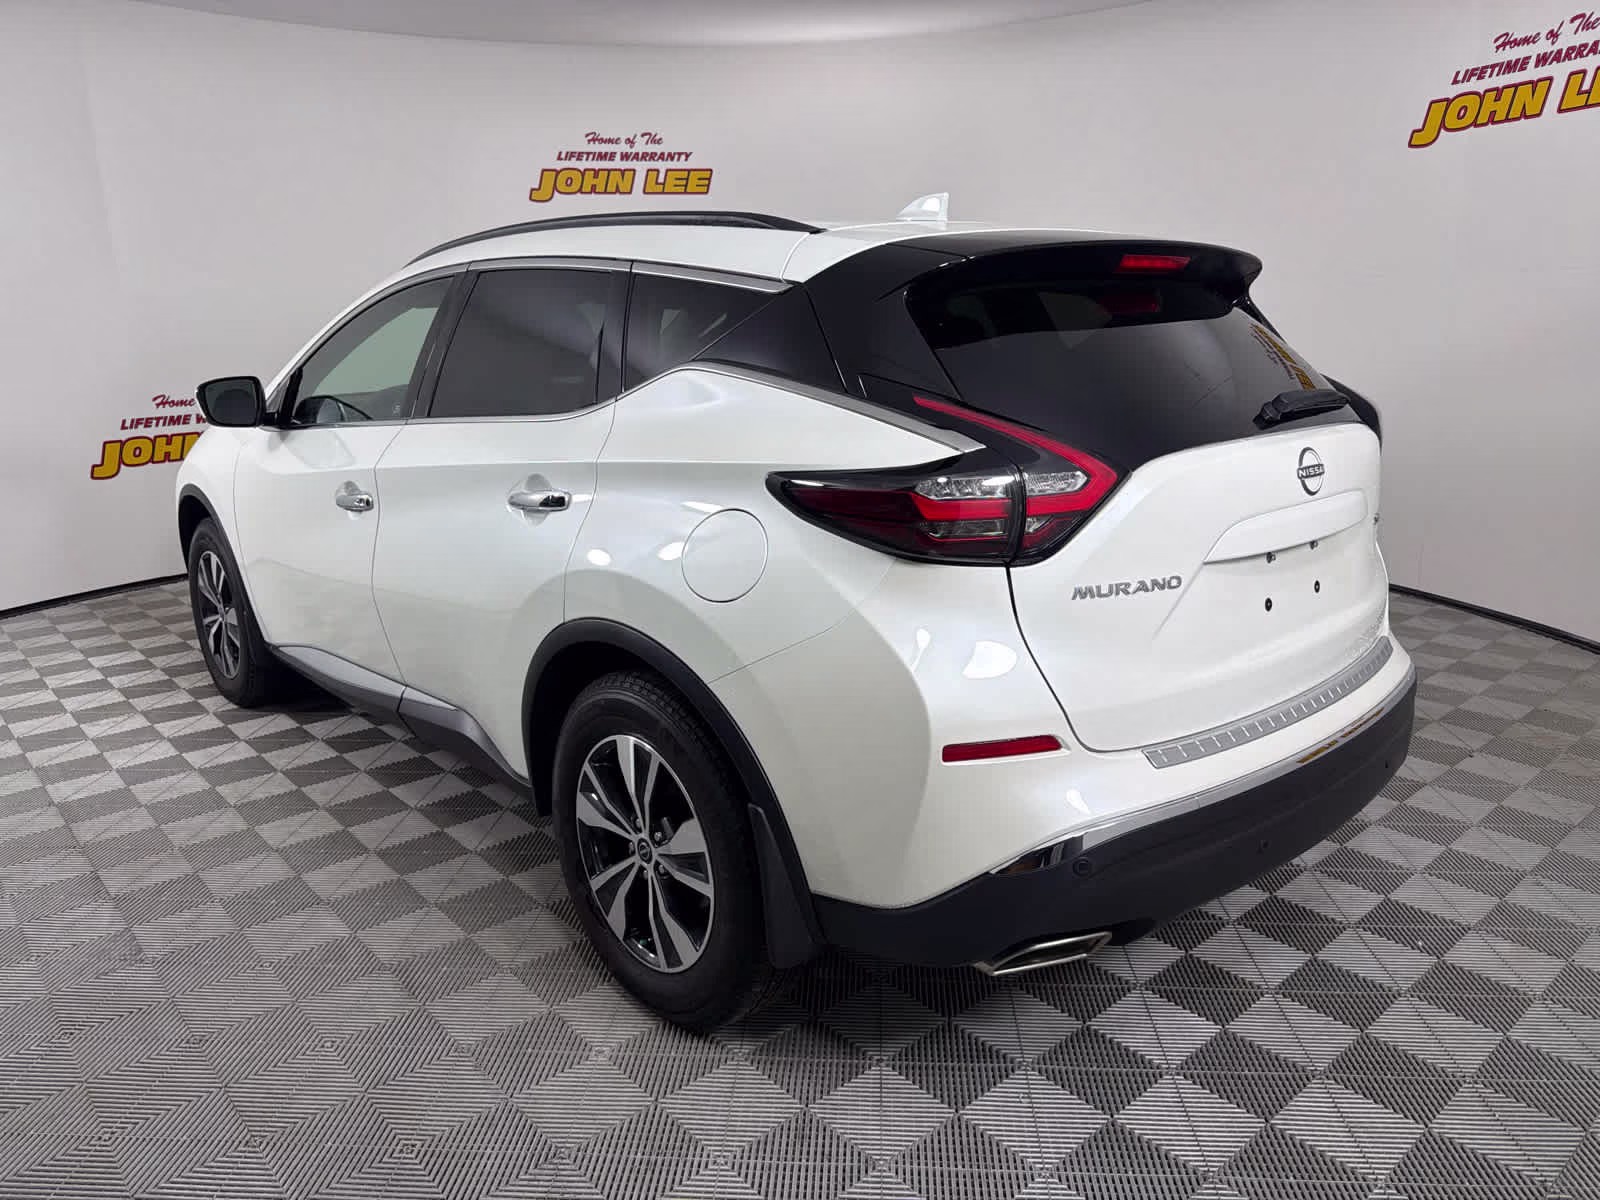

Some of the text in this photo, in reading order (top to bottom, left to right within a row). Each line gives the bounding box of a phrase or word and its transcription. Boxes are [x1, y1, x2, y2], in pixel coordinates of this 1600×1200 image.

[1493, 11, 1600, 53] Home of The
[1451, 39, 1600, 85] LIFETIME WARRA
[1408, 76, 1553, 148] JOHN
[585, 131, 663, 149] Home of The
[556, 151, 693, 162] LIFETIME WARRANTY
[529, 168, 713, 203] JOHN LEE
[152, 394, 196, 408] Home
[120, 414, 192, 430] LIFETIME
[1071, 575, 1183, 601] MURANO
